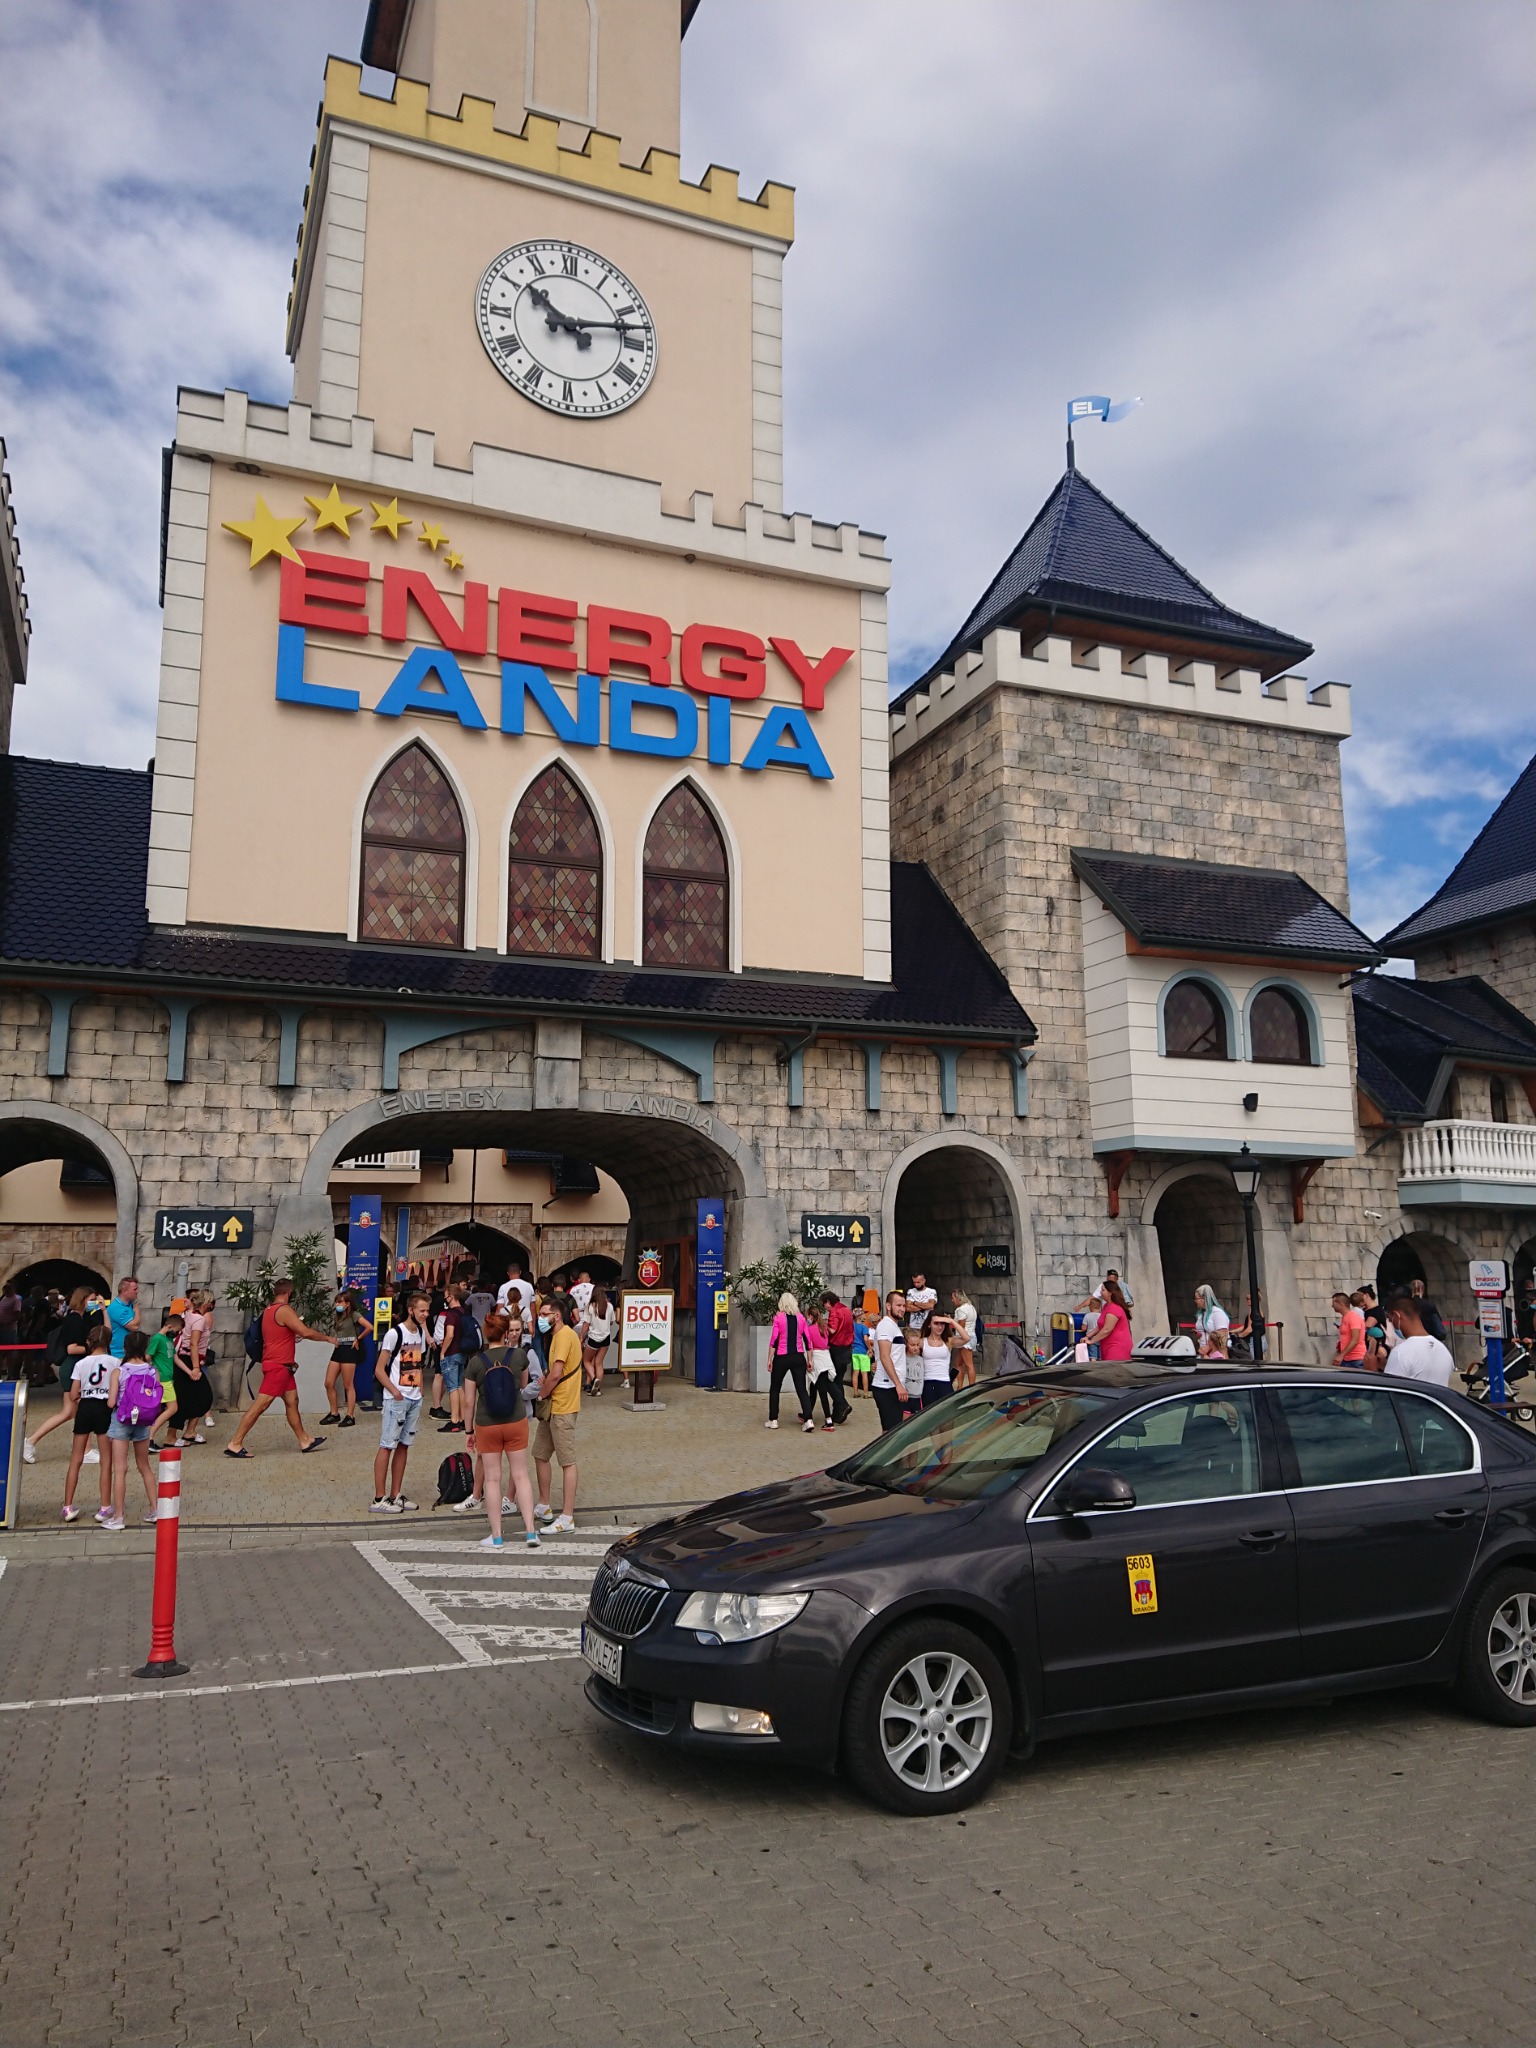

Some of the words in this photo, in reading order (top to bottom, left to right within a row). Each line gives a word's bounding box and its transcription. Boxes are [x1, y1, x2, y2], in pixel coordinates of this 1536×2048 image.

[561, 253, 579, 277] XII
[1072, 401, 1104, 415] EL
[279, 549, 855, 711] ENERGY
[275, 624, 834, 780] LANDIA
[379, 1089, 503, 1118] ENERGY
[604, 1091, 713, 1136] LANDIA
[162, 1216, 216, 1242] kasy
[807, 1220, 845, 1242] kasy
[987, 1251, 1006, 1270] kasy
[641, 1267, 658, 1278] EL
[627, 1305, 668, 1322] BON
[627, 1322, 668, 1330] TURYSTYCZNY
[1138, 1336, 1182, 1349] TAXI
[458, 1461, 467, 1492] AVIATOR
[1127, 1556, 1151, 1571] 5603
